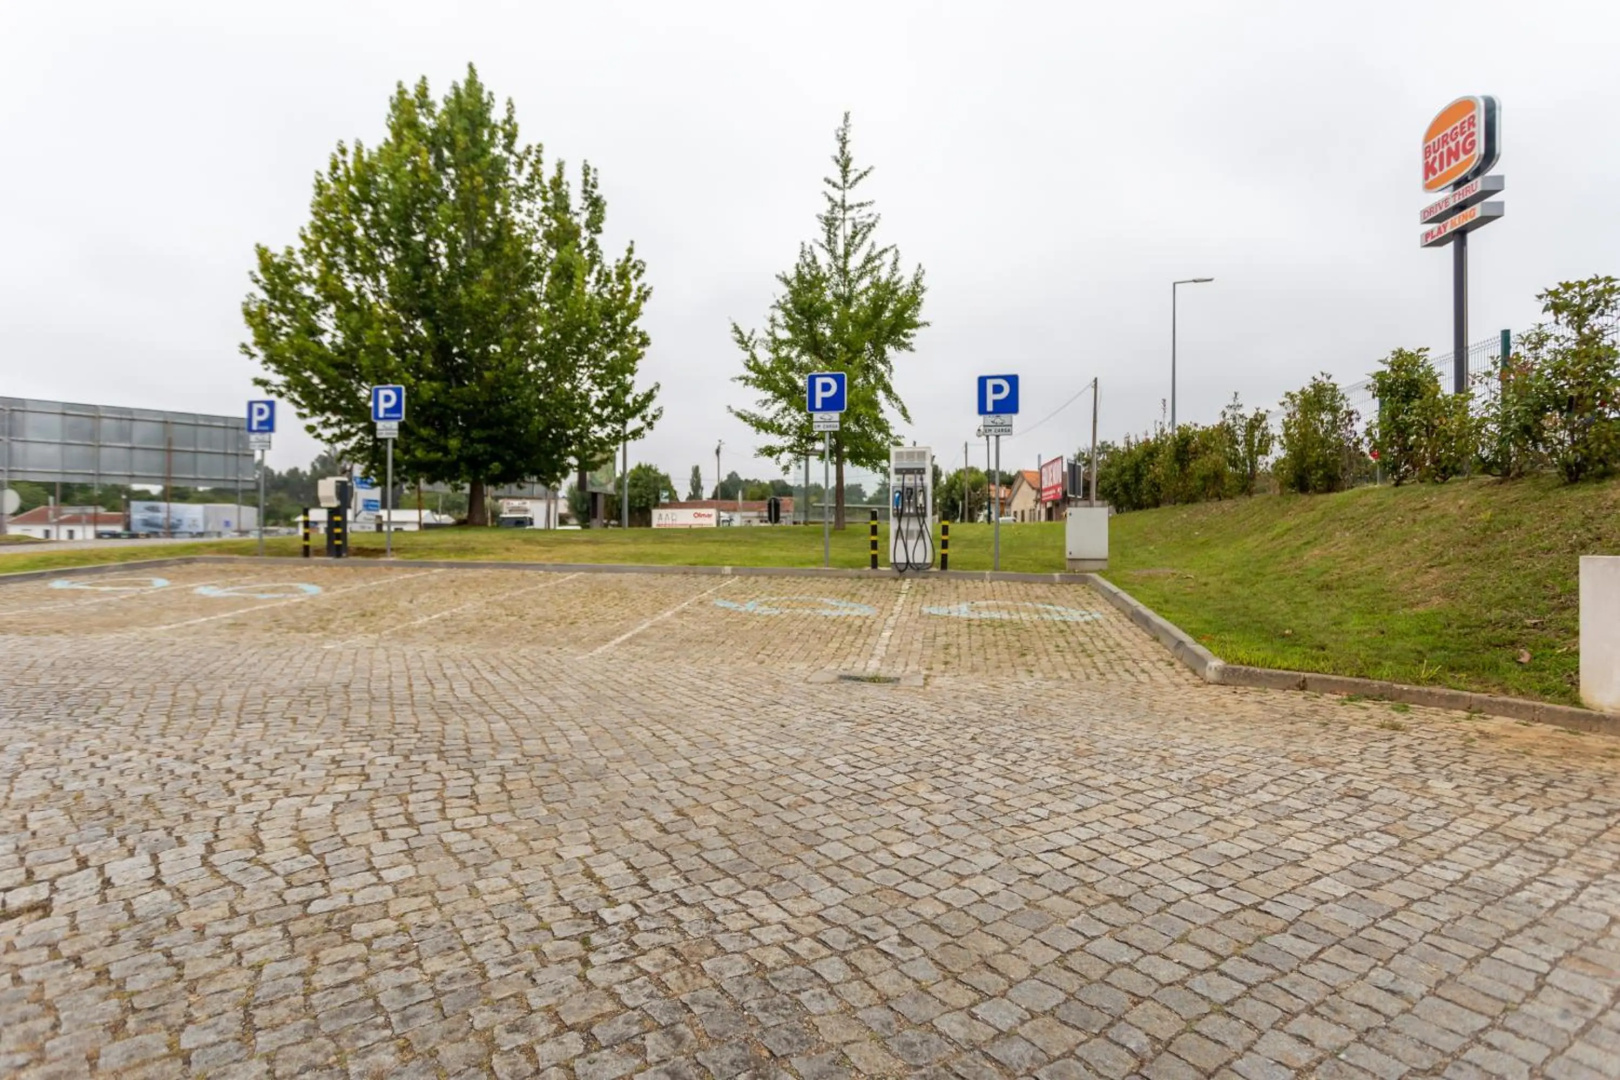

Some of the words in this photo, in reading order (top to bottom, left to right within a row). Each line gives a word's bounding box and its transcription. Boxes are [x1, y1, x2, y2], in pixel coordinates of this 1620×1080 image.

[1424, 114, 1476, 160] BURGER
[1424, 131, 1477, 181] KING
[1423, 197, 1450, 220] DRIVE
[1452, 180, 1478, 203] THRU
[1424, 222, 1448, 242] PLAY
[1450, 207, 1476, 229] KING
[378, 389, 397, 418] P
[815, 377, 838, 409] P
[986, 379, 1010, 412] P
[252, 403, 270, 430] P
